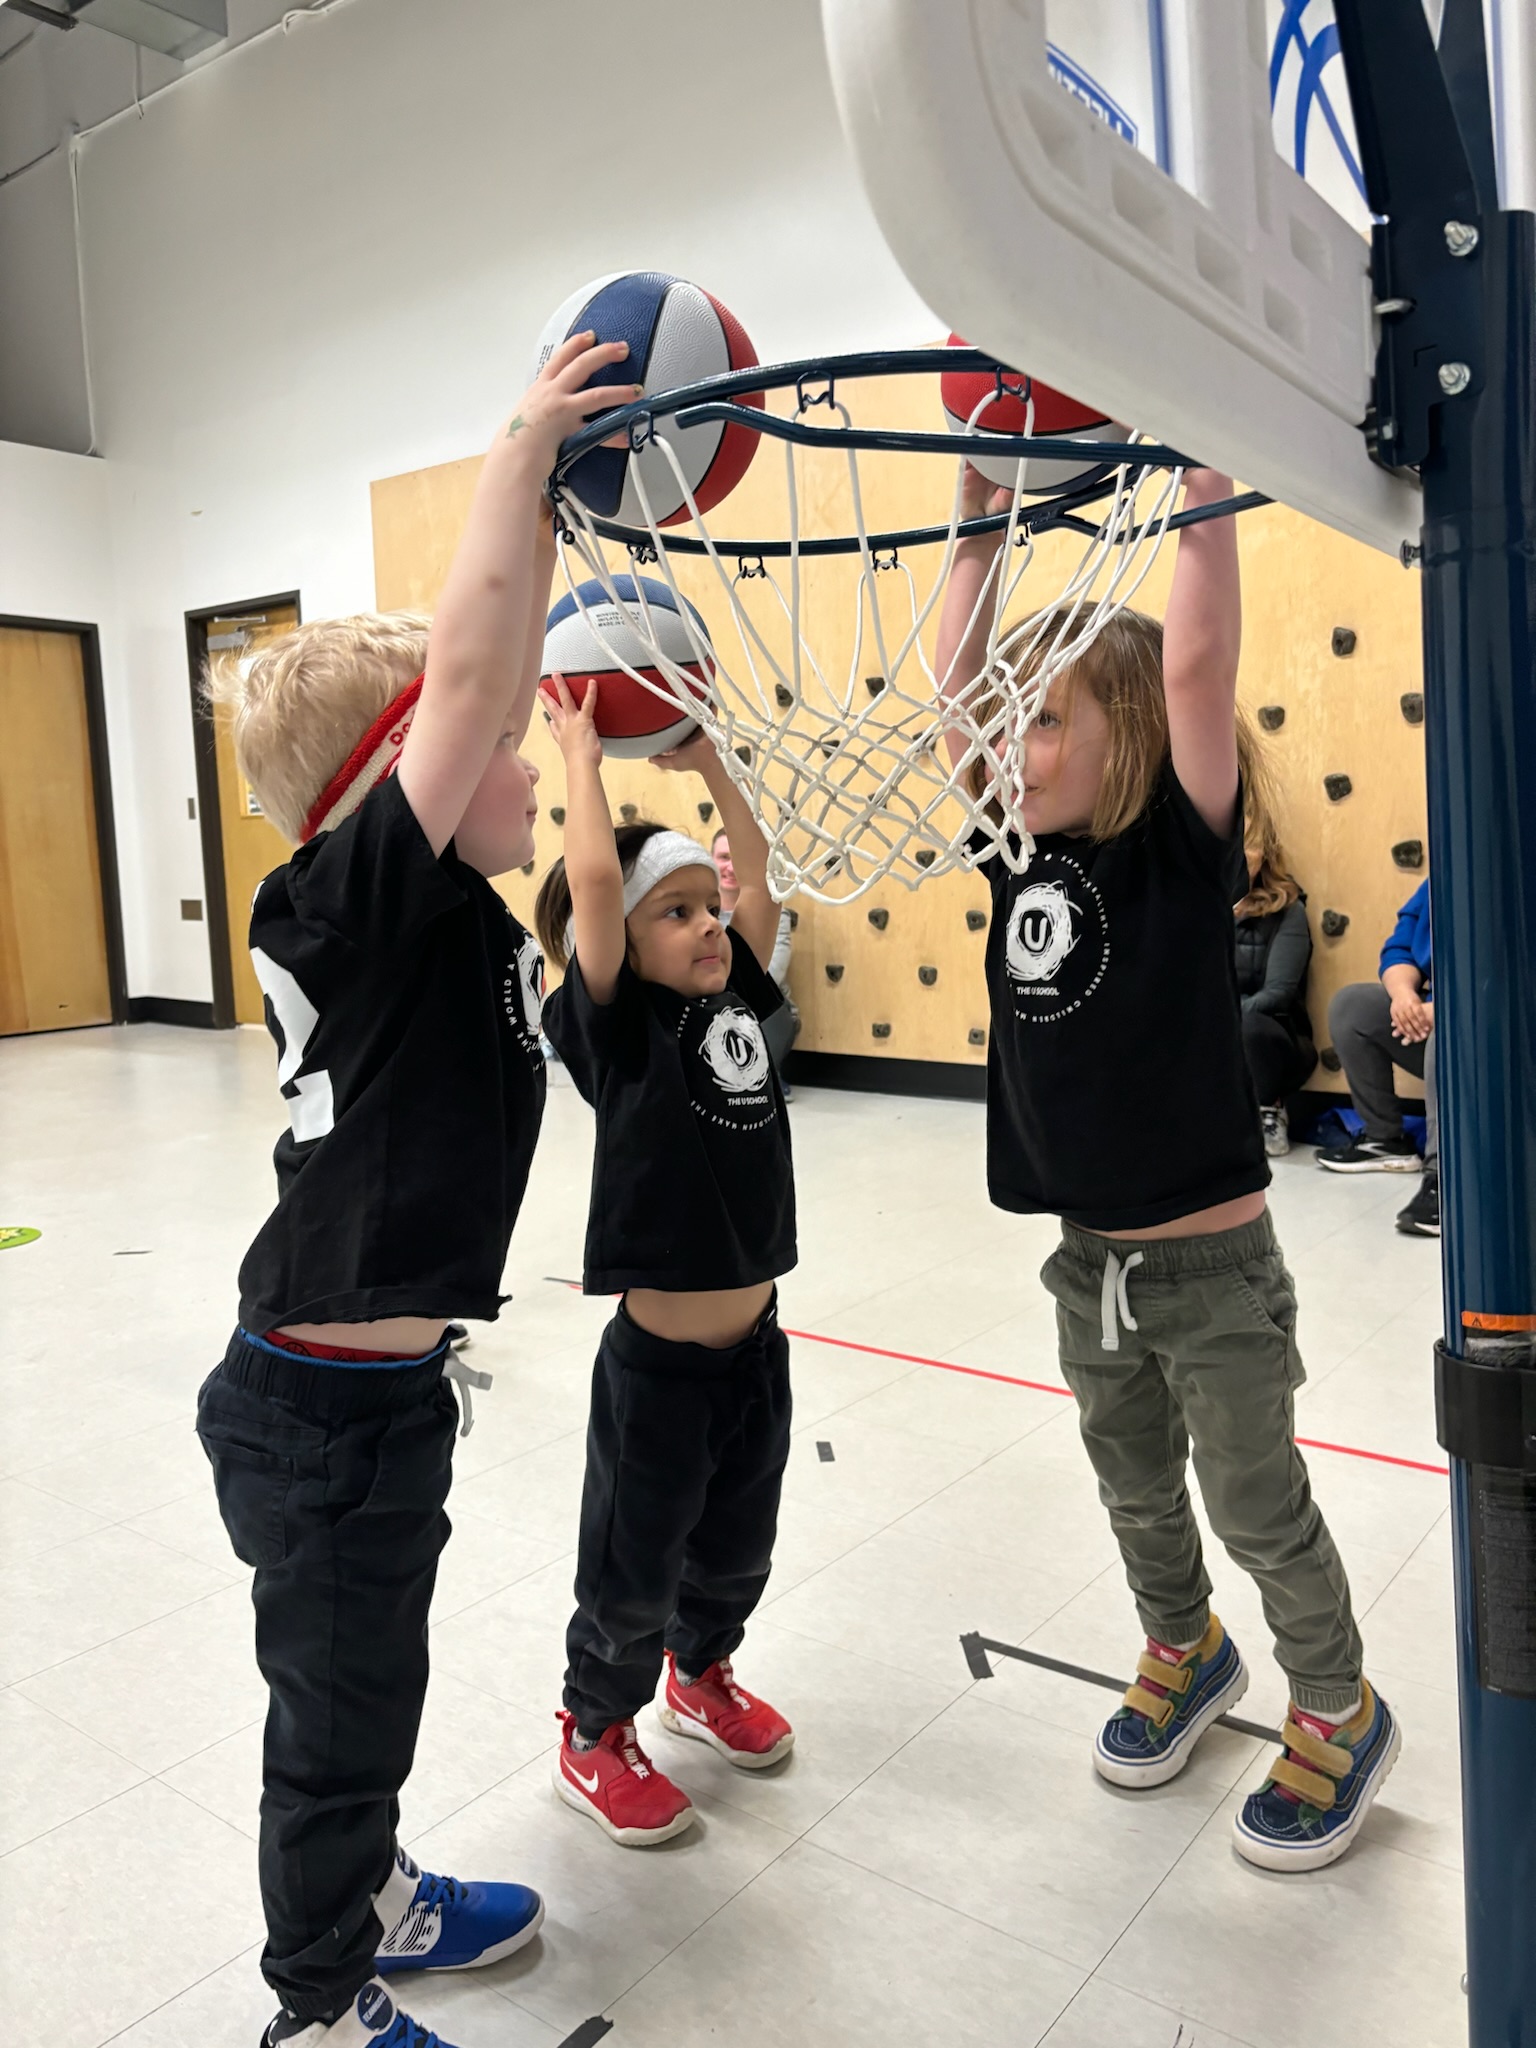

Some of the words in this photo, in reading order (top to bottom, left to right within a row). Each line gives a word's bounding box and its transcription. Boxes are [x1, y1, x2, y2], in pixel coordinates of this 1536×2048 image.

[1024, 917, 1048, 951] U
[503, 978, 518, 1026] WORLD
[729, 1035, 748, 1066] U
